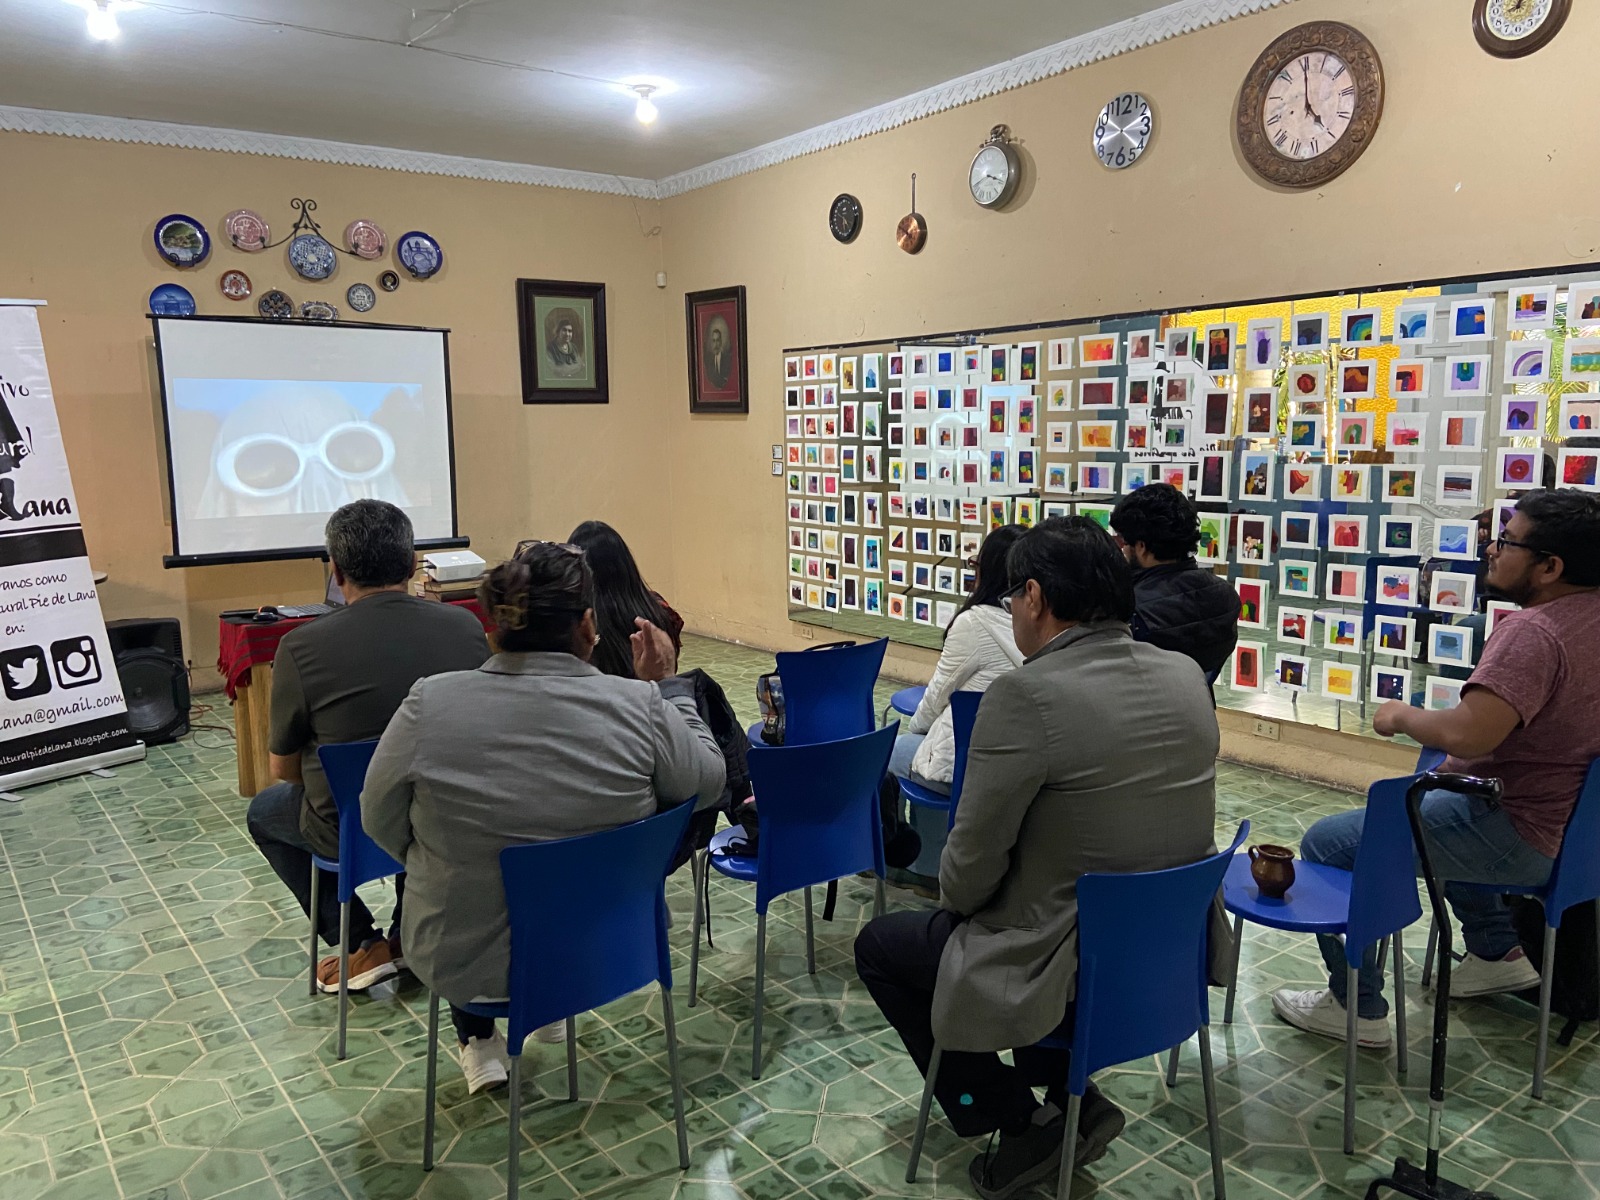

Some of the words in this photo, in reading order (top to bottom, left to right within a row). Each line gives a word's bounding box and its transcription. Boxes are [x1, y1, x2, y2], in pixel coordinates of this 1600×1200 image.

[1115, 94, 1133, 117] 12
[1139, 102, 1148, 117] 2
[1139, 116, 1151, 136] 3
[1095, 125, 1106, 146] 9
[1097, 144, 1105, 158] 8
[1137, 137, 1144, 150] 4
[1106, 151, 1115, 166] 7
[1115, 146, 1126, 166] 6
[1127, 147, 1136, 161] 5
[35, 573, 67, 586] como
[0, 597, 29, 614] ural
[28, 593, 50, 608] Pie
[51, 591, 66, 606] de
[67, 589, 97, 602] Lana
[5, 624, 26, 636] en:
[0, 693, 124, 731] ana@gmail.com
